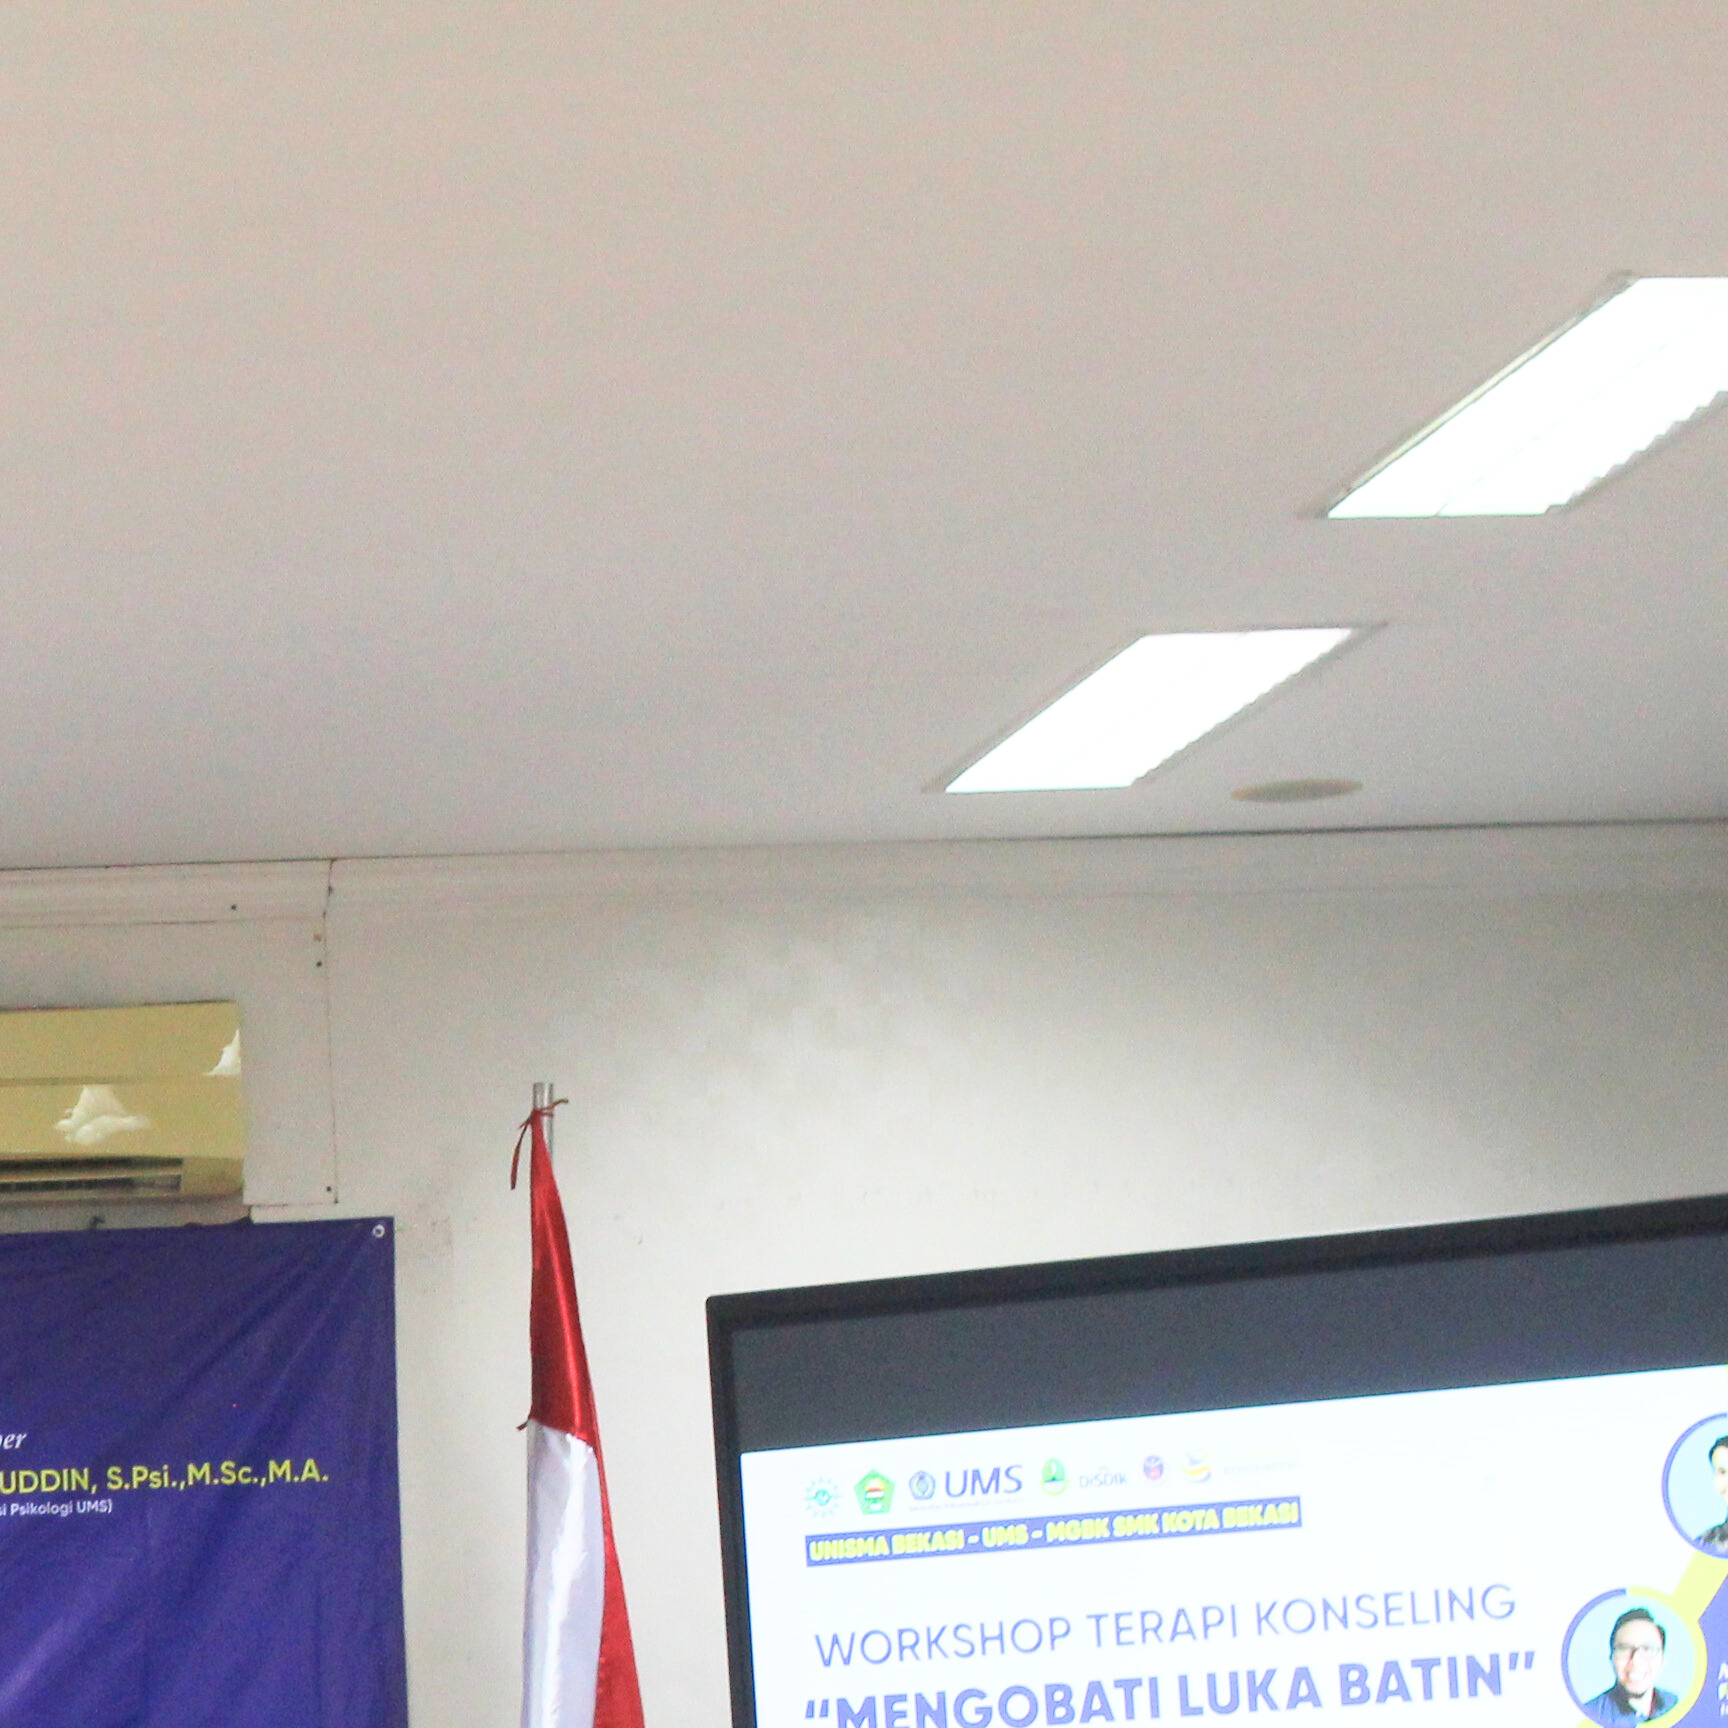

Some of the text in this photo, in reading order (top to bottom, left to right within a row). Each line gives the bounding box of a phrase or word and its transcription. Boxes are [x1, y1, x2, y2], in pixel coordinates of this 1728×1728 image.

[106, 1459, 329, 1490] S.Psi.,M.Sc.,M.A.
[945, 1465, 1023, 1498] UMS
[11, 1500, 73, 1519] Psikologi
[76, 1499, 113, 1515] UMS)
[809, 1535, 890, 1560] UNISMA
[892, 1529, 965, 1555] BEKASI
[982, 1524, 1029, 1547] UMS
[1113, 1513, 1159, 1537] SMK
[1162, 1509, 1220, 1533] KOTA
[1222, 1501, 1298, 1528] BEKASI
[815, 1584, 1515, 1668] WORKSHOP TERAPI KONSELING
[1178, 1667, 1323, 1717] LUKA
[1339, 1651, 1535, 1707] BATIN”
